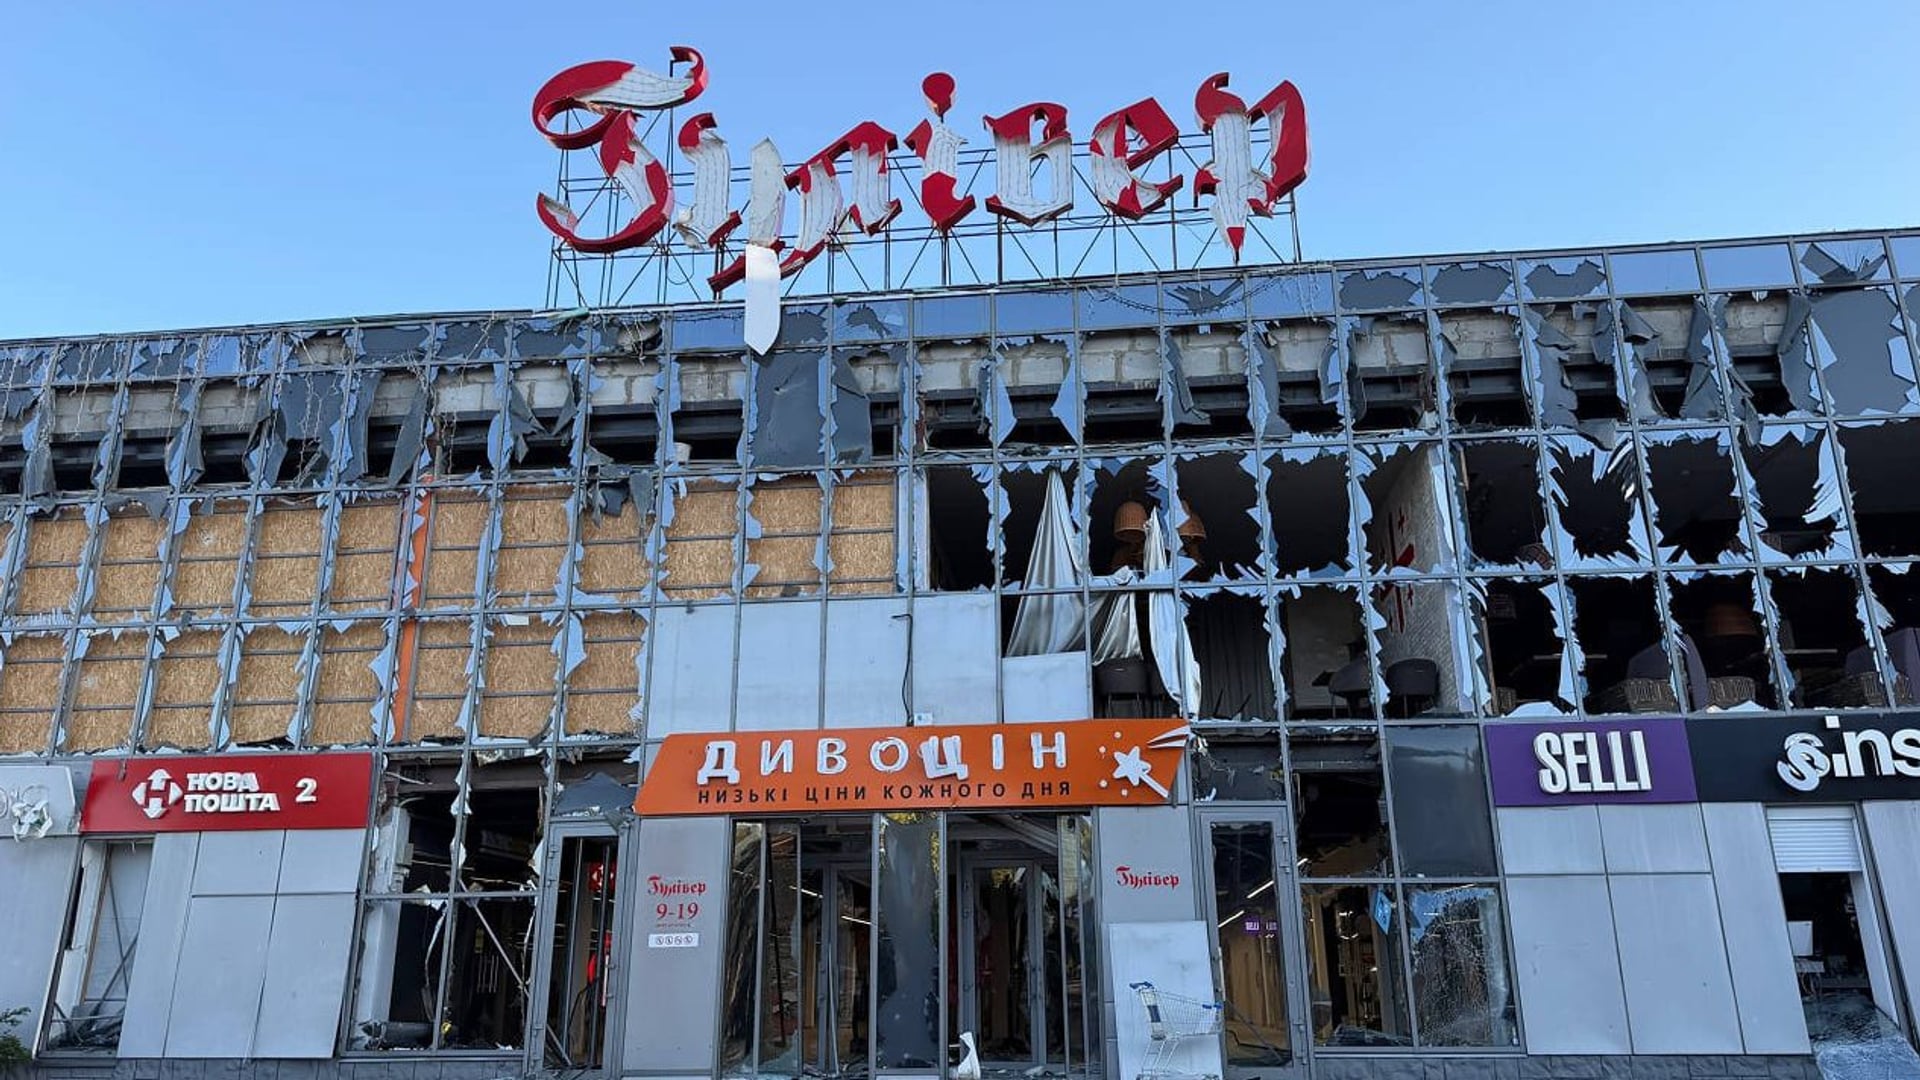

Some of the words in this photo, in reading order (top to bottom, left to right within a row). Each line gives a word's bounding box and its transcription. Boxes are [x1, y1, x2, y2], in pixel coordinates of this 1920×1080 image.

[697, 732, 1067, 785] ДИВОЦІН
[1533, 731, 1652, 793] SELLI
[186, 772, 260, 792] НОВА
[295, 778, 317, 802] 2
[698, 788, 788, 804] НИЗЬКІ
[806, 785, 866, 804] ЦІНИ
[884, 782, 1006, 800] КОЖНОГО
[1022, 781, 1070, 798] ДНЯ
[184, 793, 281, 812] ПОШТА
[648, 876, 706, 897] Гулівер
[1115, 866, 1179, 889] Гулівер
[657, 902, 699, 920] 9-19
